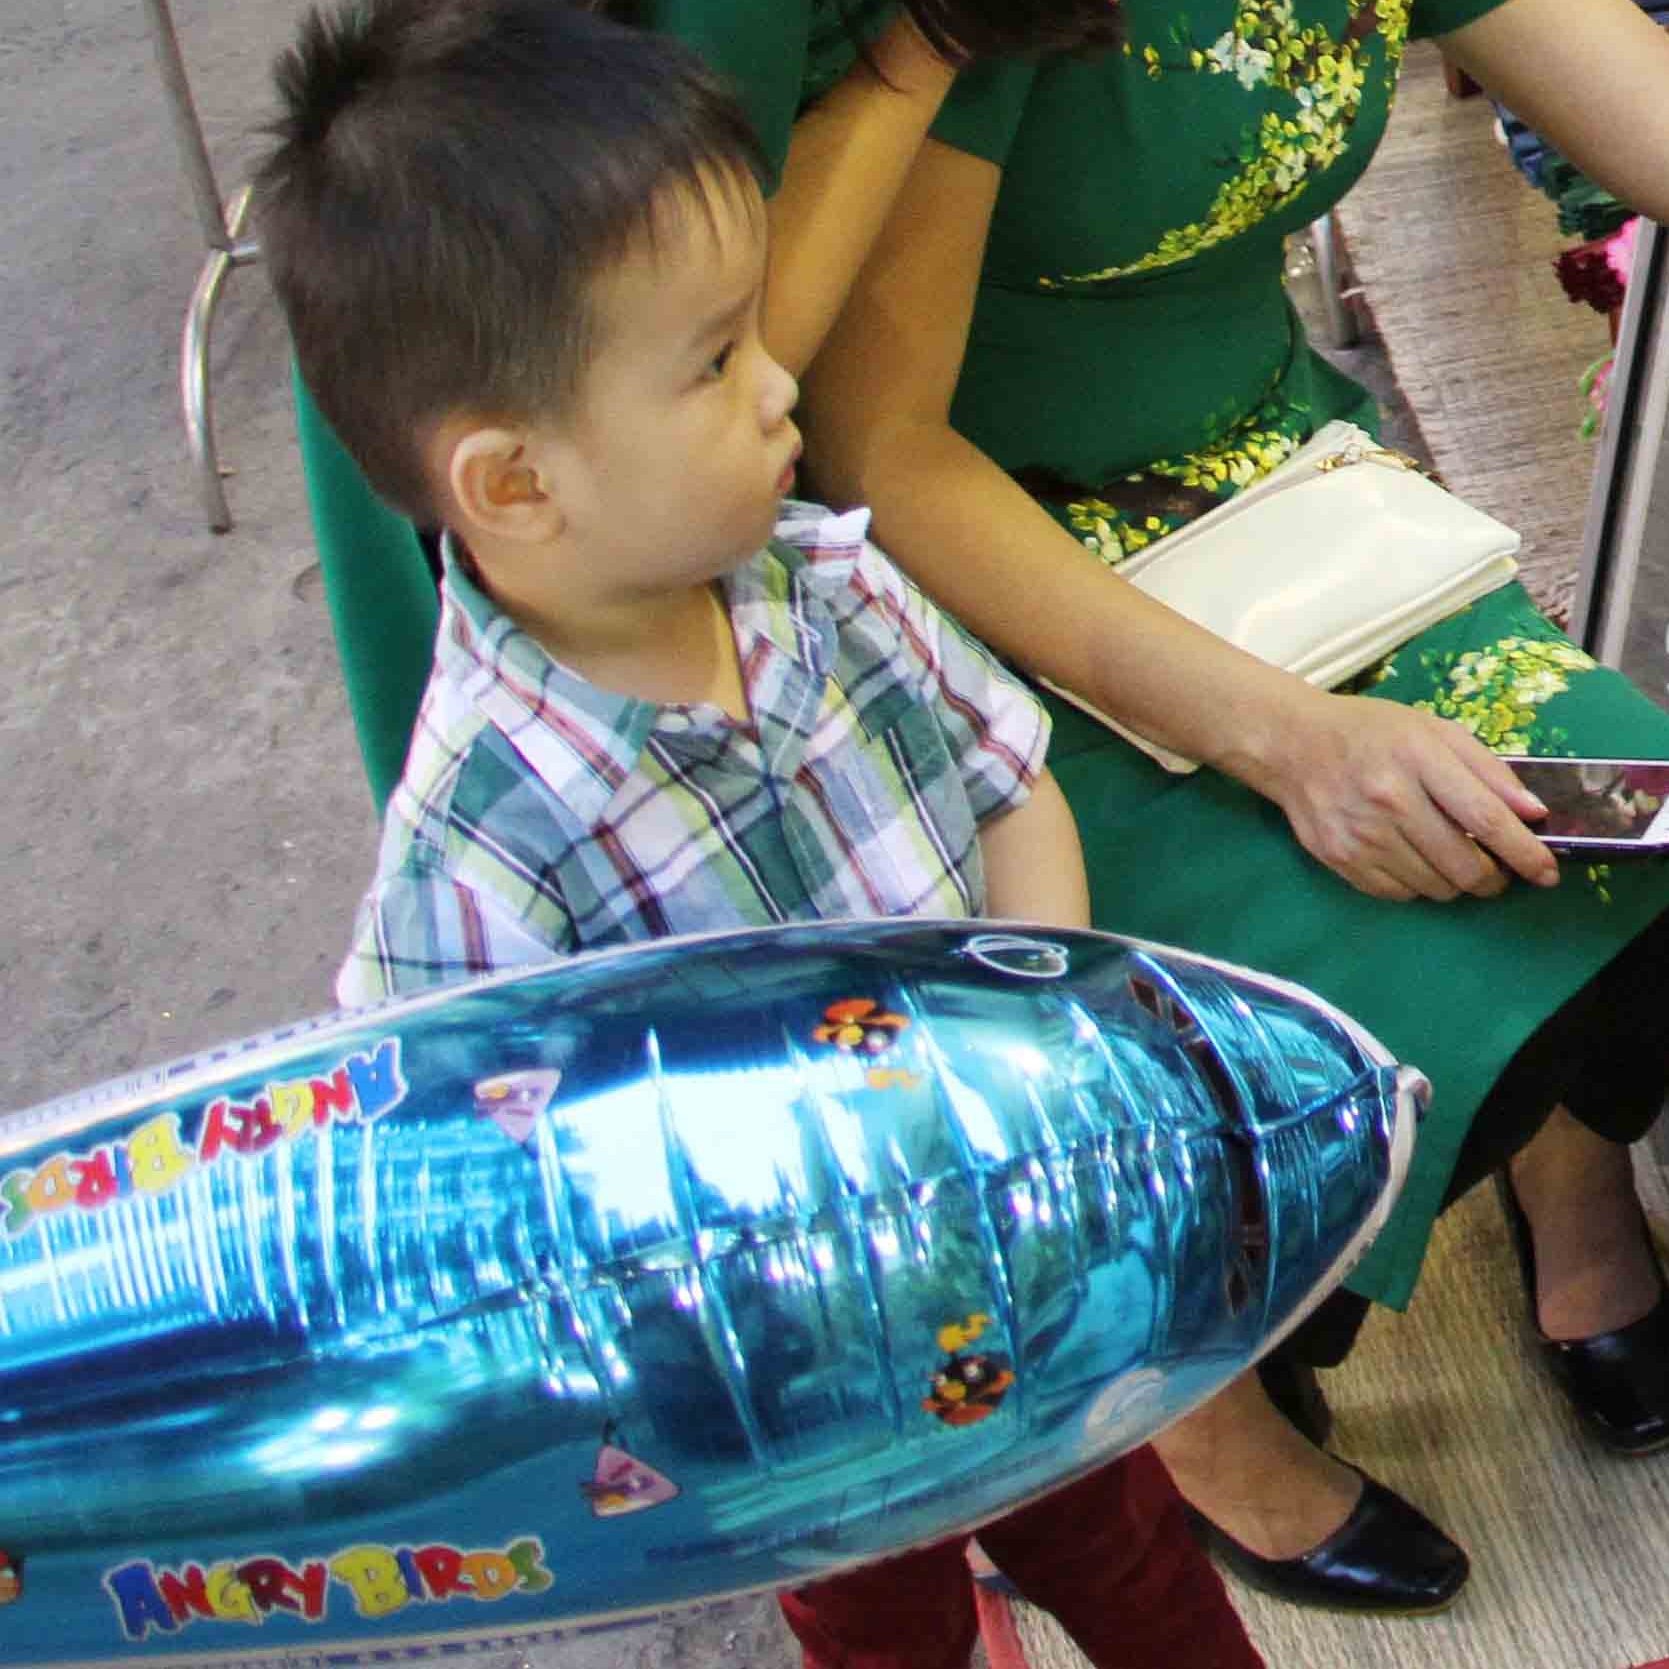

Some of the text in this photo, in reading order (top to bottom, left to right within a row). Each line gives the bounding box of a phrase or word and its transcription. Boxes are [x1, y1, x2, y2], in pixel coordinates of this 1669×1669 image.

[197, 1036, 407, 1163] ANGRY
[0, 1113, 202, 1229] BIRDS
[104, 1536, 554, 1641] ANGRY BIRDS
